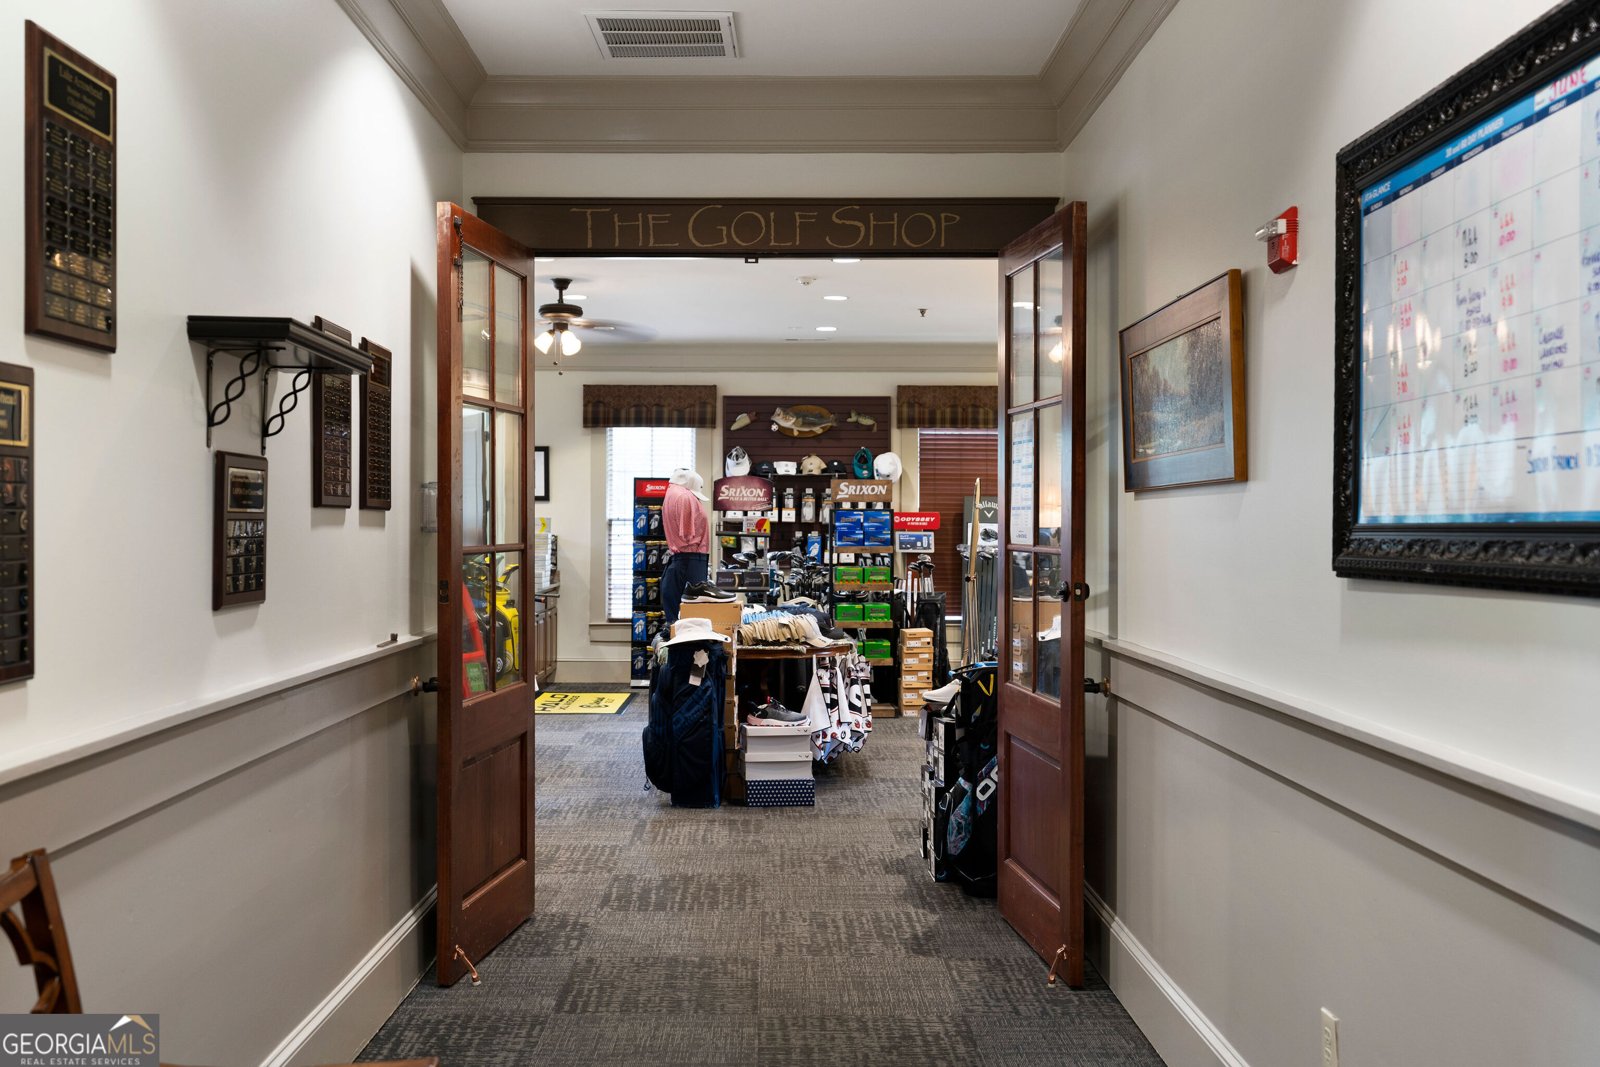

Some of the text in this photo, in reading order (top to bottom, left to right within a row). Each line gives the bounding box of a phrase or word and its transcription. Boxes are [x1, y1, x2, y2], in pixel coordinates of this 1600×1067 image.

[570, 204, 961, 248] THE GOLF SHOP
[718, 485, 766, 500] SRIXON
[836, 482, 888, 499] SRIXON
